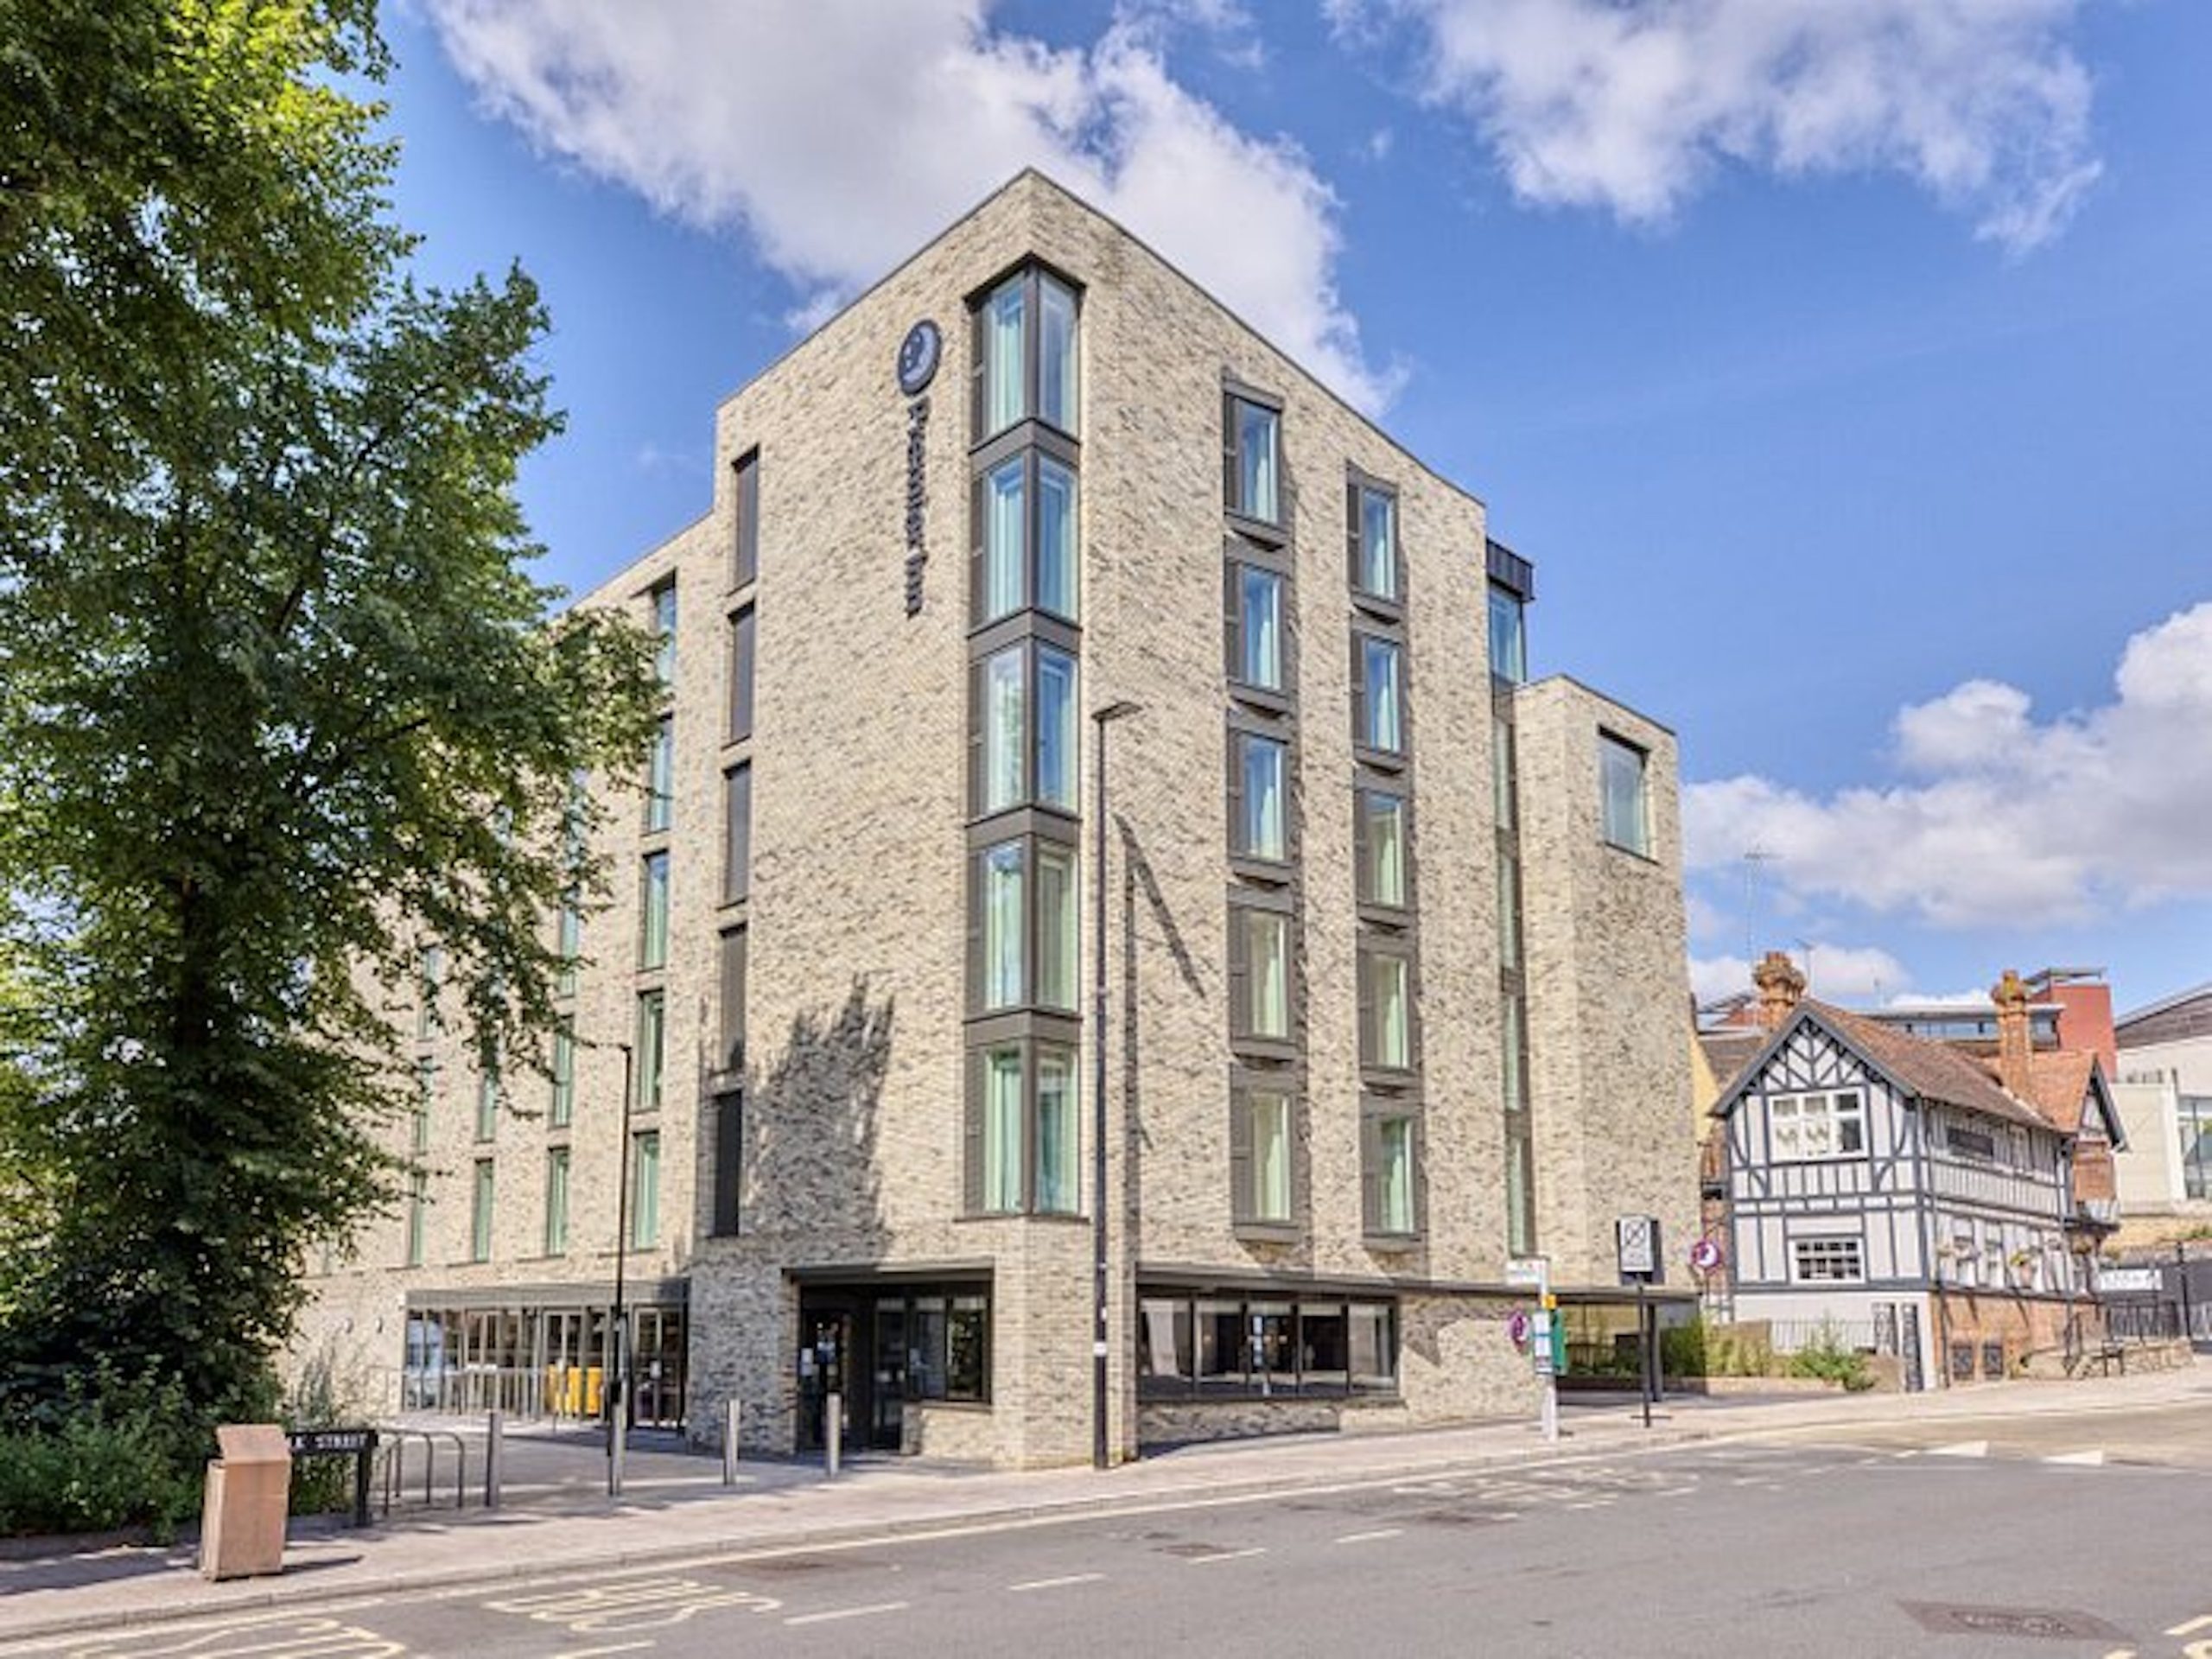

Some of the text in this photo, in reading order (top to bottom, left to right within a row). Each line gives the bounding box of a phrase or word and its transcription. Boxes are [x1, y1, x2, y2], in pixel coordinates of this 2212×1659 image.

[905, 397, 930, 619] Premier Inn
[314, 1433, 368, 1450] STREET
